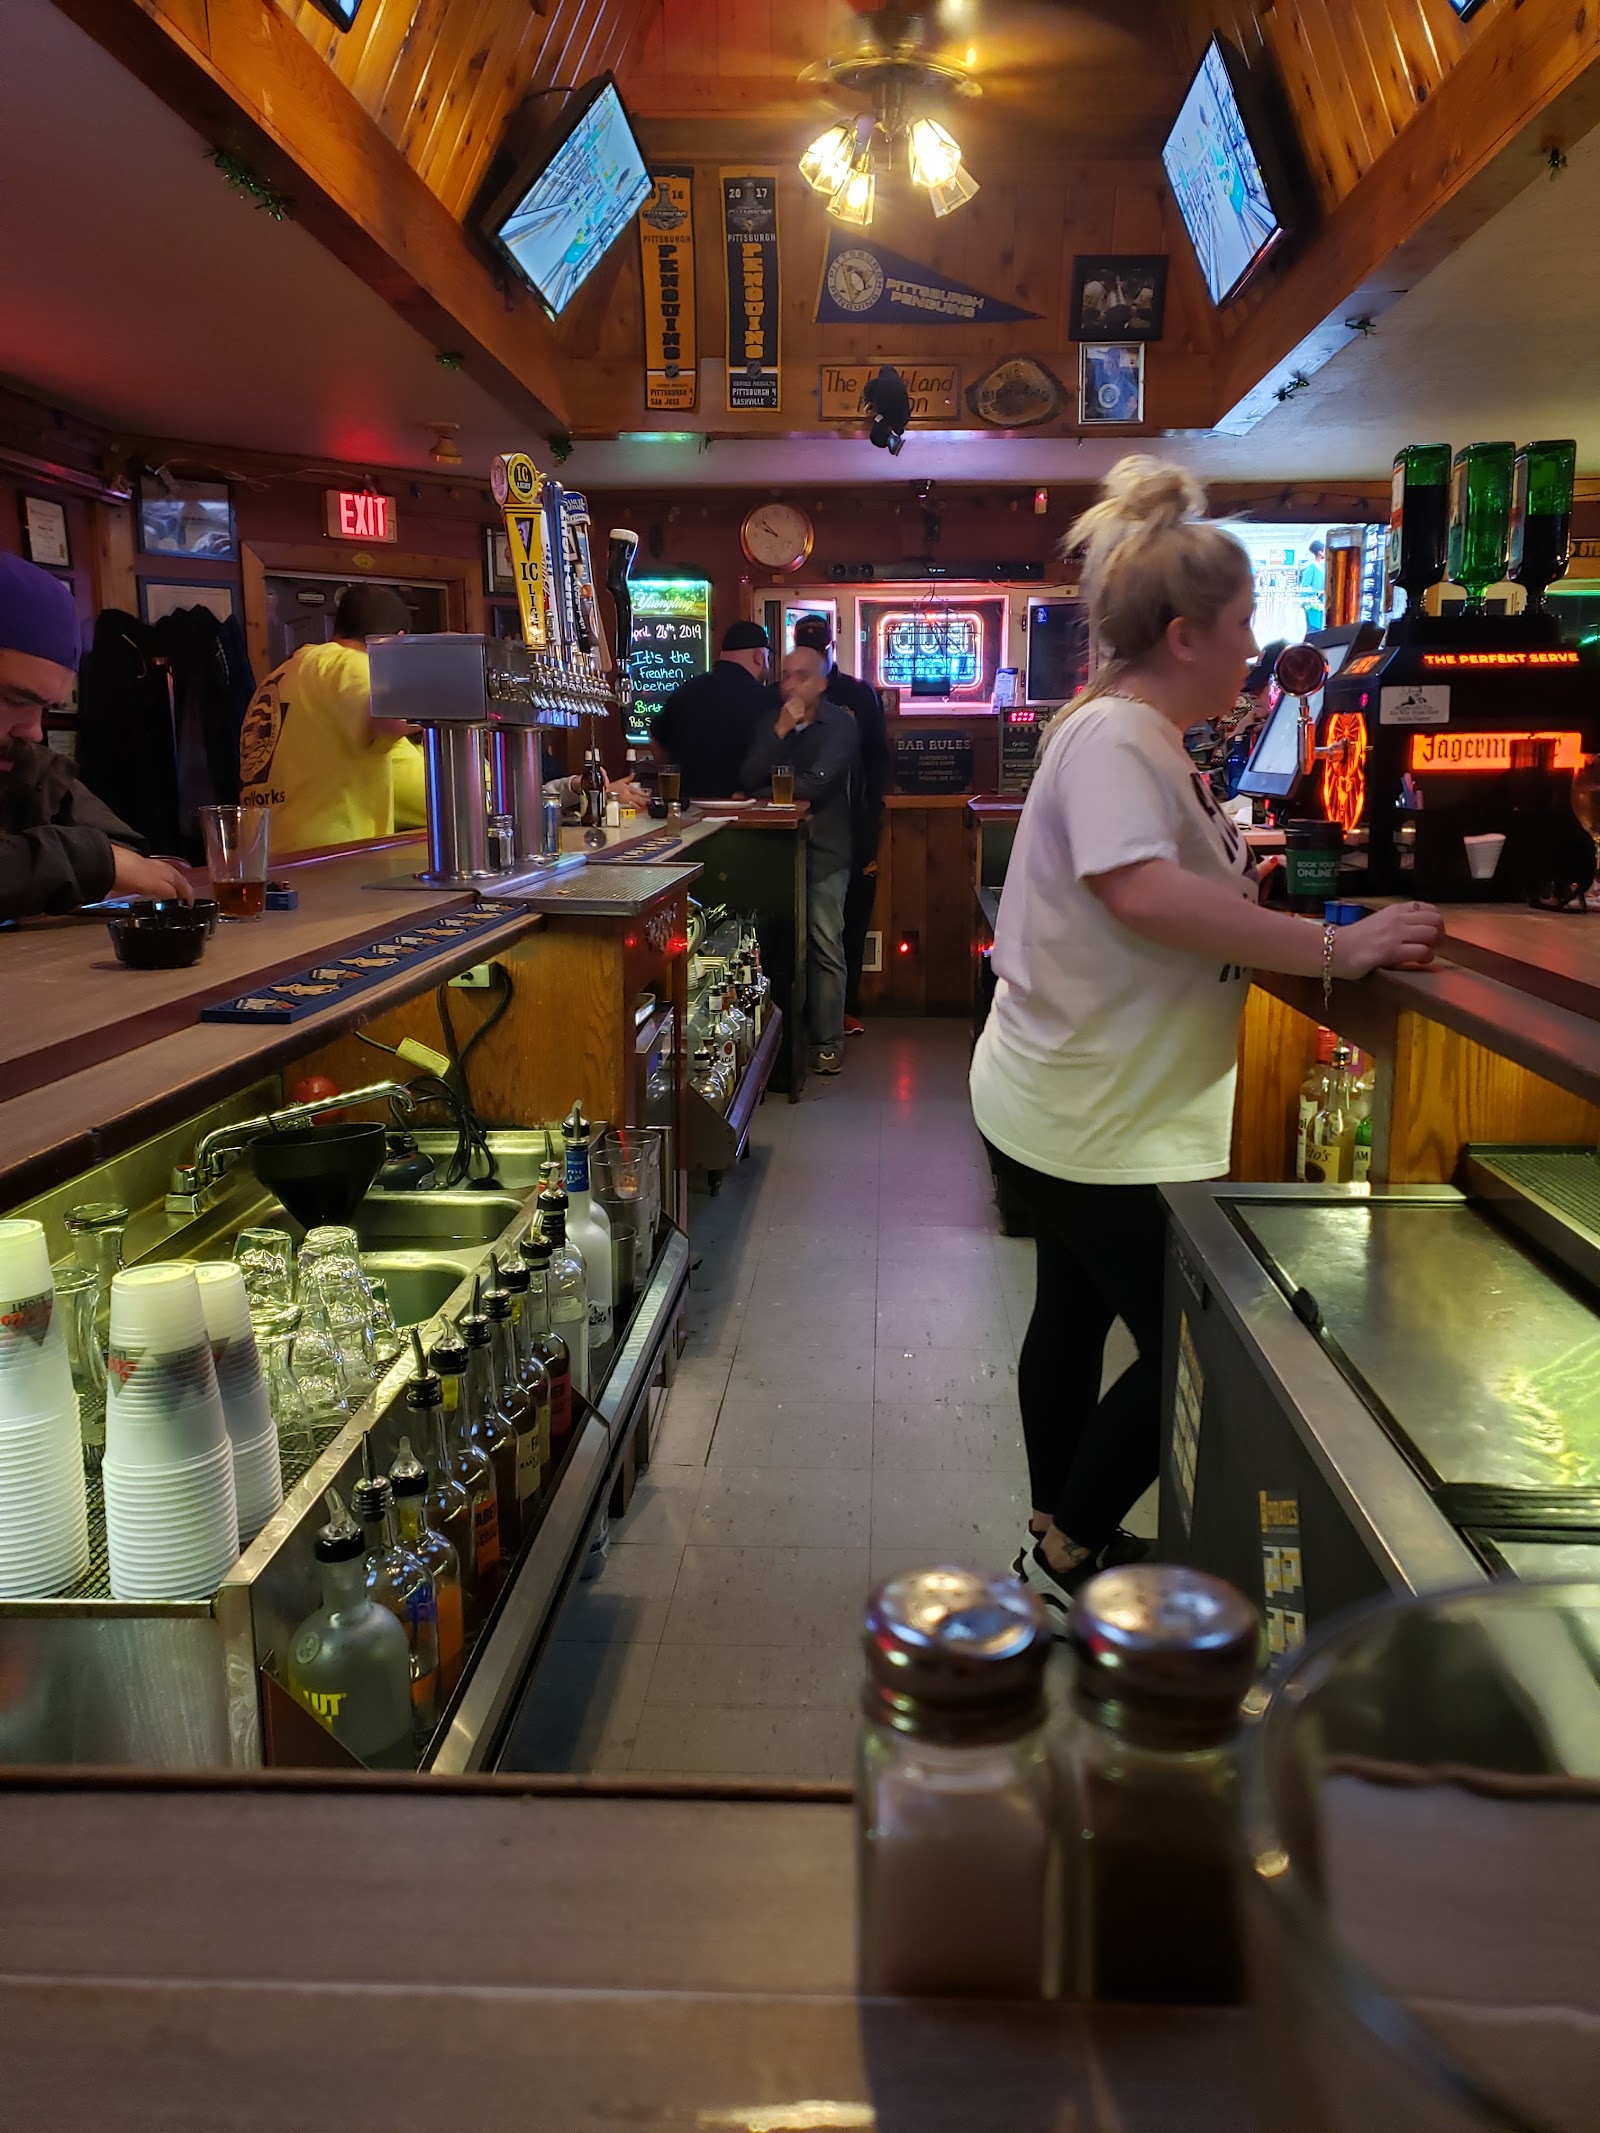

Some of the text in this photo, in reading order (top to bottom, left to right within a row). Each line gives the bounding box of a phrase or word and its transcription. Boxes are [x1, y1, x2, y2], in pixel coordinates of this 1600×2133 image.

[672, 190, 684, 200] 16
[729, 188, 767, 198] 20 17
[643, 235, 691, 243] PITTSBURGH
[727, 233, 776, 242] PITTSBURGH
[885, 277, 985, 309] PITTSBURGH
[658, 244, 680, 360] PENGUINS
[742, 242, 765, 359] PENGUINS
[890, 290, 976, 318] PENGUINS
[826, 369, 857, 392] The
[650, 388, 687, 396] PITTSBURGH
[732, 387, 777, 396] PITTSBURGH 4
[650, 398, 662, 406] SAN
[664, 398, 680, 406] JOSE
[732, 398, 777, 406] NASHVILLE 2
[339, 492, 386, 537] EXIT
[632, 591, 697, 612] Yuengling
[679, 624, 702, 640] 2019
[630, 650, 694, 666] It's the
[1424, 652, 1580, 665] THE PERFEKT SERVE
[897, 739, 972, 751] BAR RULES
[1296, 868, 1332, 878] ONLINE
